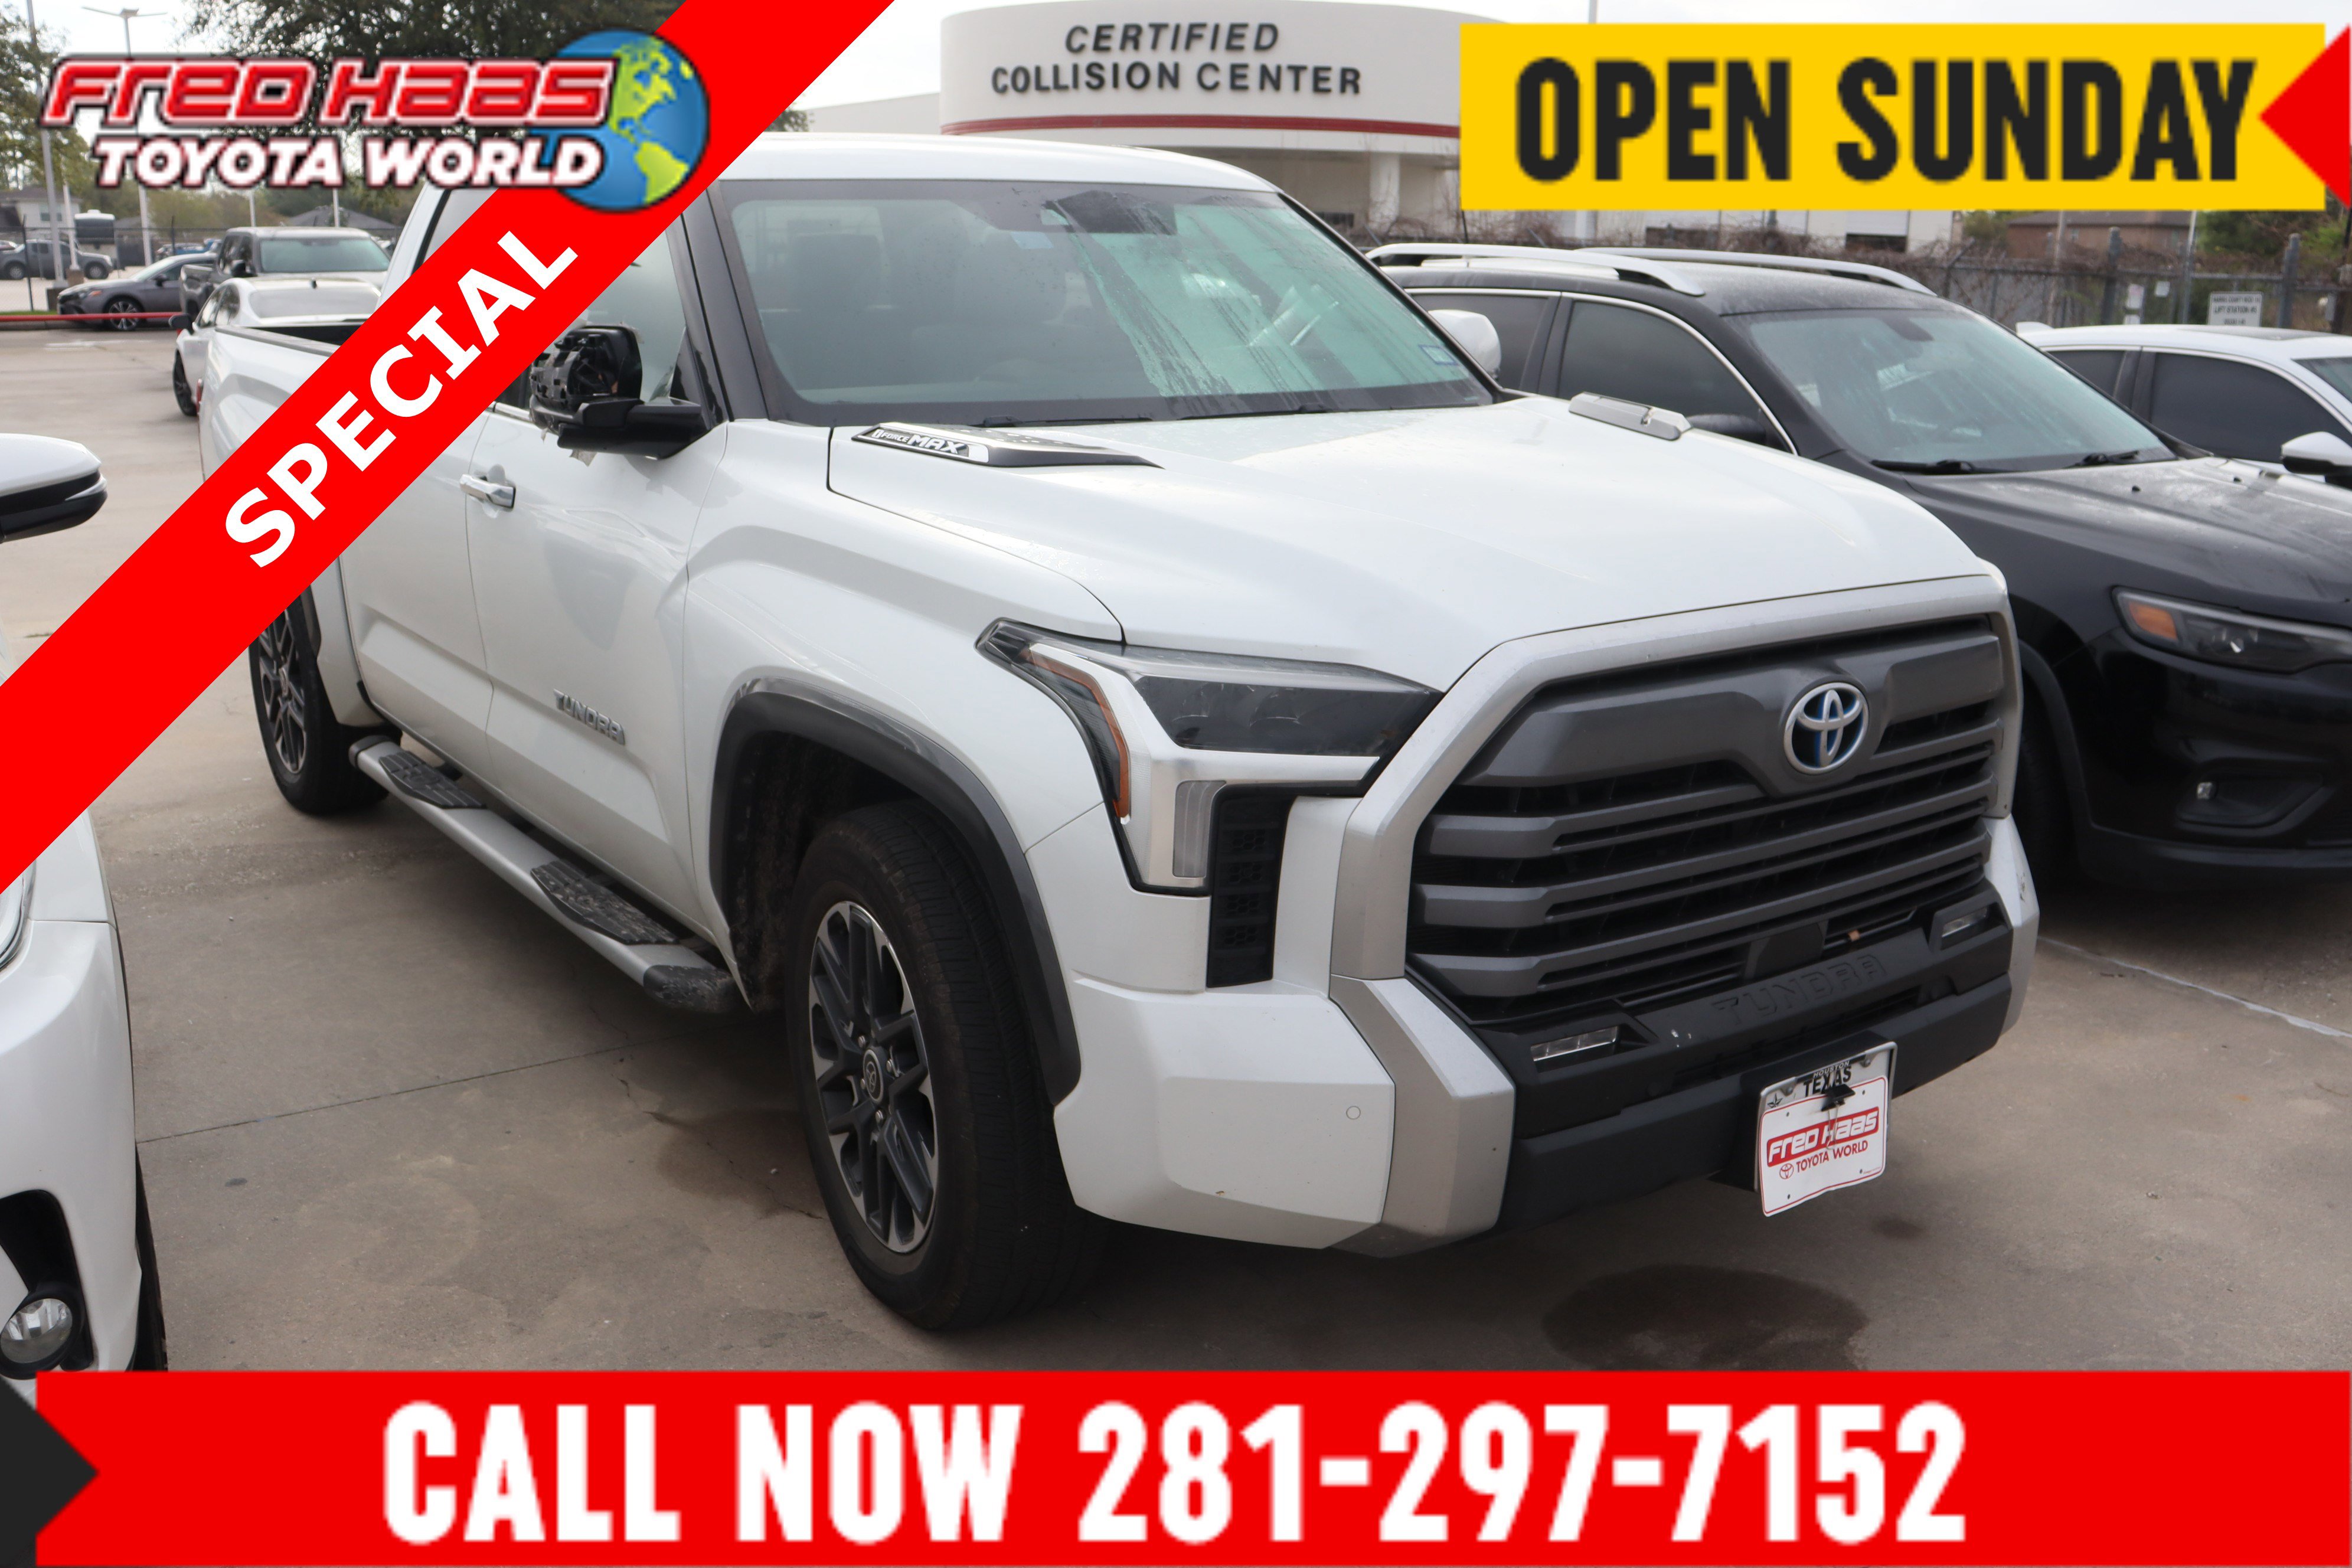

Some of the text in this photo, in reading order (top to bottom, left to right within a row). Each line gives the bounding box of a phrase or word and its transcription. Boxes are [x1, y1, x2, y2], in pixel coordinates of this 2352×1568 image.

[1065, 22, 1279, 52] CERTIFIED
[991, 61, 1361, 94] COLLISION CENTER
[907, 435, 966, 454] MAX
[553, 688, 626, 746] TUNDRA
[1711, 954, 1888, 1026] TUNDRA
[1803, 1065, 1852, 1097] TEXAS
[1813, 1060, 1850, 1079] HOUSTON
[1796, 1140, 1868, 1172] TOYOTA WORLD
